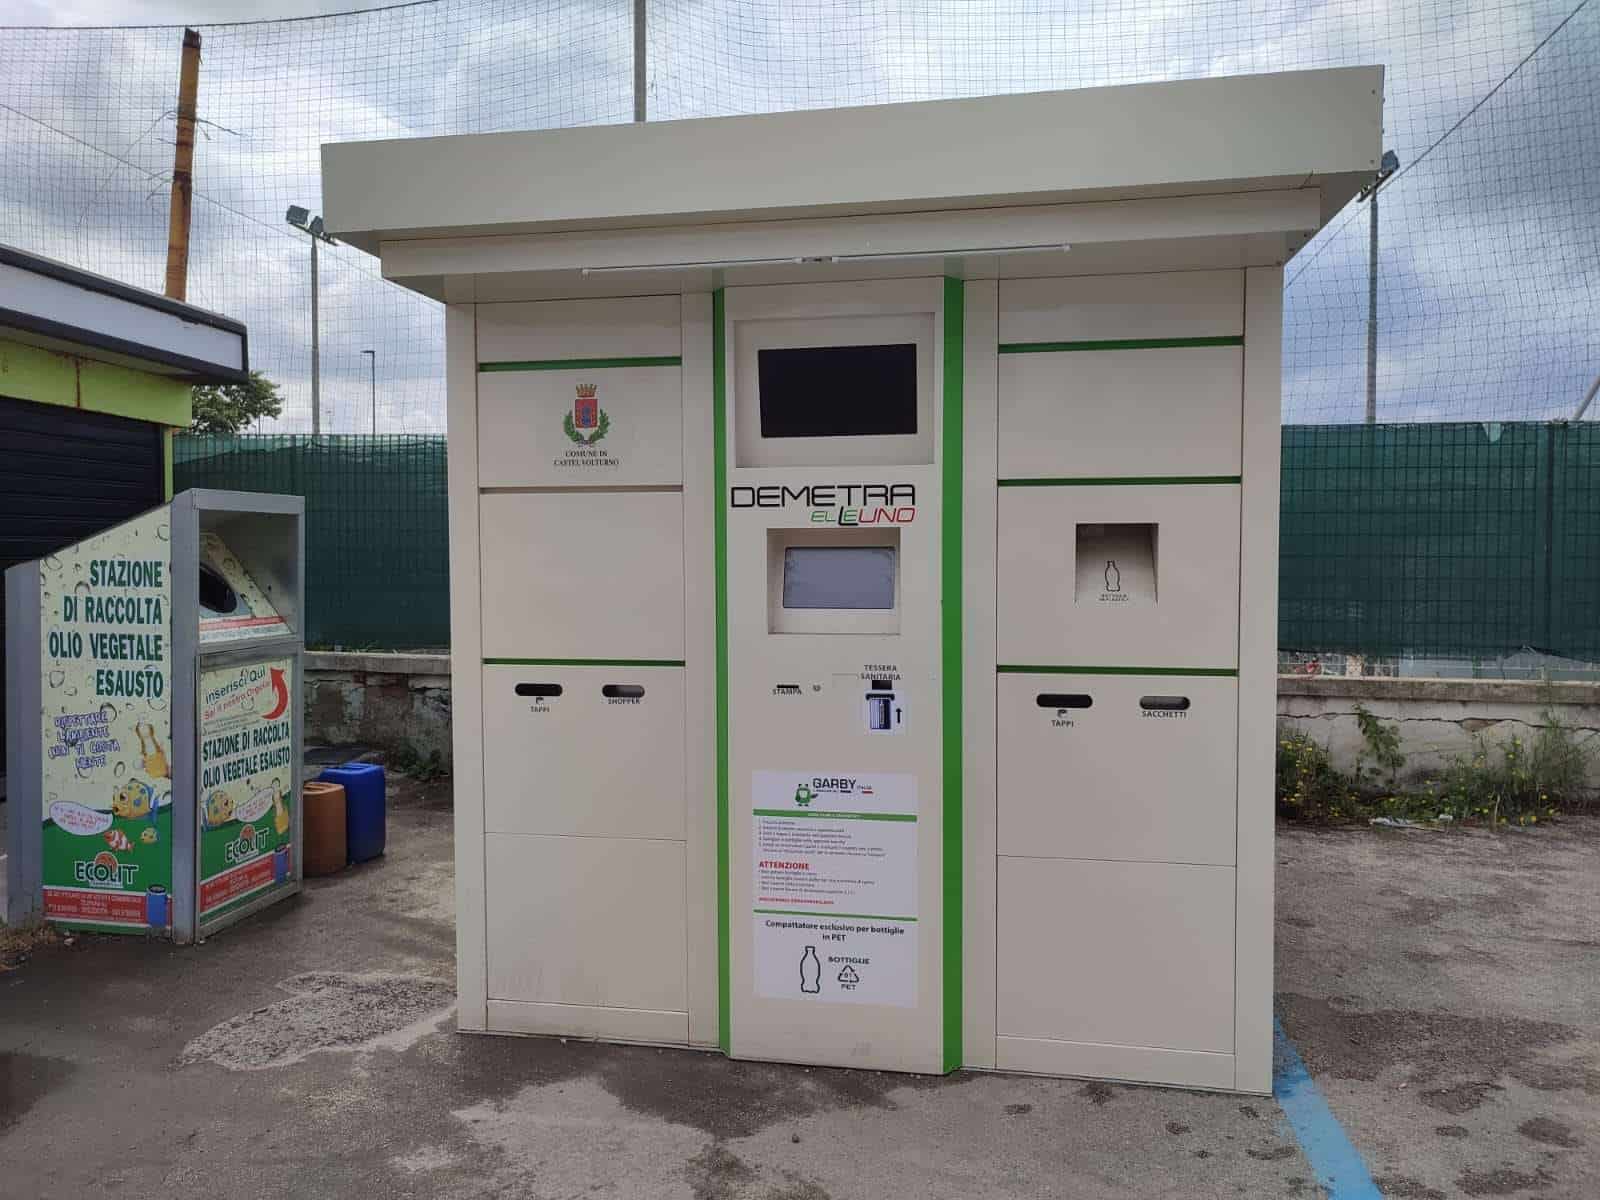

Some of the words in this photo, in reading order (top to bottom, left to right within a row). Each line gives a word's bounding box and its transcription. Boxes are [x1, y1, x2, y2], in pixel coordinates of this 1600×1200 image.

[731, 485, 915, 507] DEMETRA
[90, 559, 164, 588] STAZIONE
[63, 595, 79, 623] DI
[85, 596, 163, 625] RACCOLTA
[49, 631, 83, 659] OLIO
[89, 633, 164, 662] VEGETALE
[863, 664, 898, 672] TESSERA
[860, 672, 902, 681] SANITARIA
[96, 669, 164, 698] ESAUSTO
[772, 687, 802, 696] STAMPA
[530, 705, 550, 713] TAPPI
[1141, 710, 1188, 719] SACCHETTI
[1051, 719, 1075, 728] TAPPI
[203, 733, 239, 762] STAZIONE
[241, 730, 251, 751] DI
[253, 720, 290, 748] RACCOLTA
[203, 765, 220, 789] OLIO
[222, 754, 258, 783] VEGETALE
[260, 746, 290, 773] ESAUSTO
[812, 778, 857, 790] GARBY
[759, 860, 810, 871] ATTENZIONE
[765, 919, 819, 931] Compattatore
[820, 922, 855, 932] esclusivo
[856, 925, 869, 934] per
[870, 926, 905, 936] bottiglie
[822, 933, 831, 941] in
[831, 933, 847, 942] PET
[828, 956, 871, 965] BOTTIGLIE
[841, 983, 857, 991] PET
